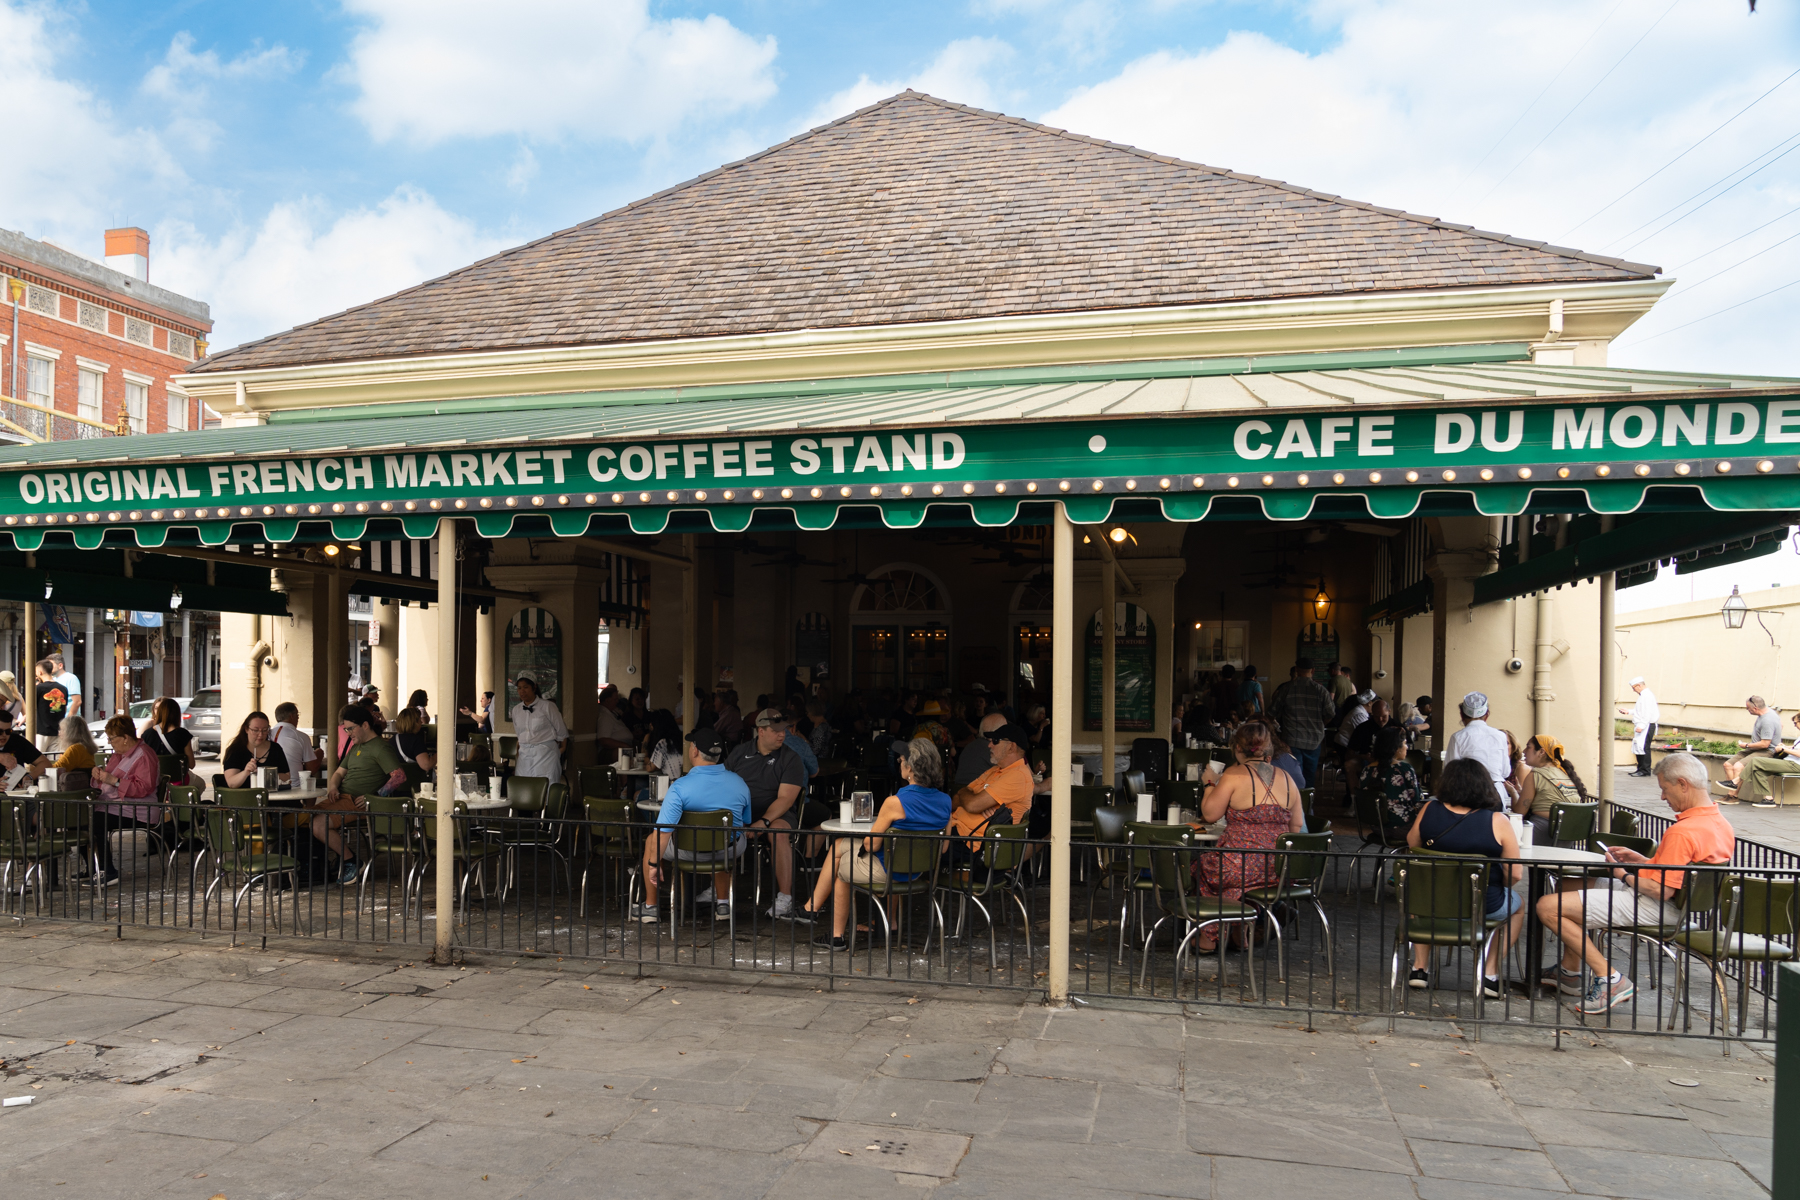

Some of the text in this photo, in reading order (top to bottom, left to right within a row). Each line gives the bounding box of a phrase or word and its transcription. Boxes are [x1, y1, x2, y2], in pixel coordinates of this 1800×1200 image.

[19, 400, 1800, 505] ORIGINAL FRENCH MARKET COFFEE STAND CAFE DU MONDE
